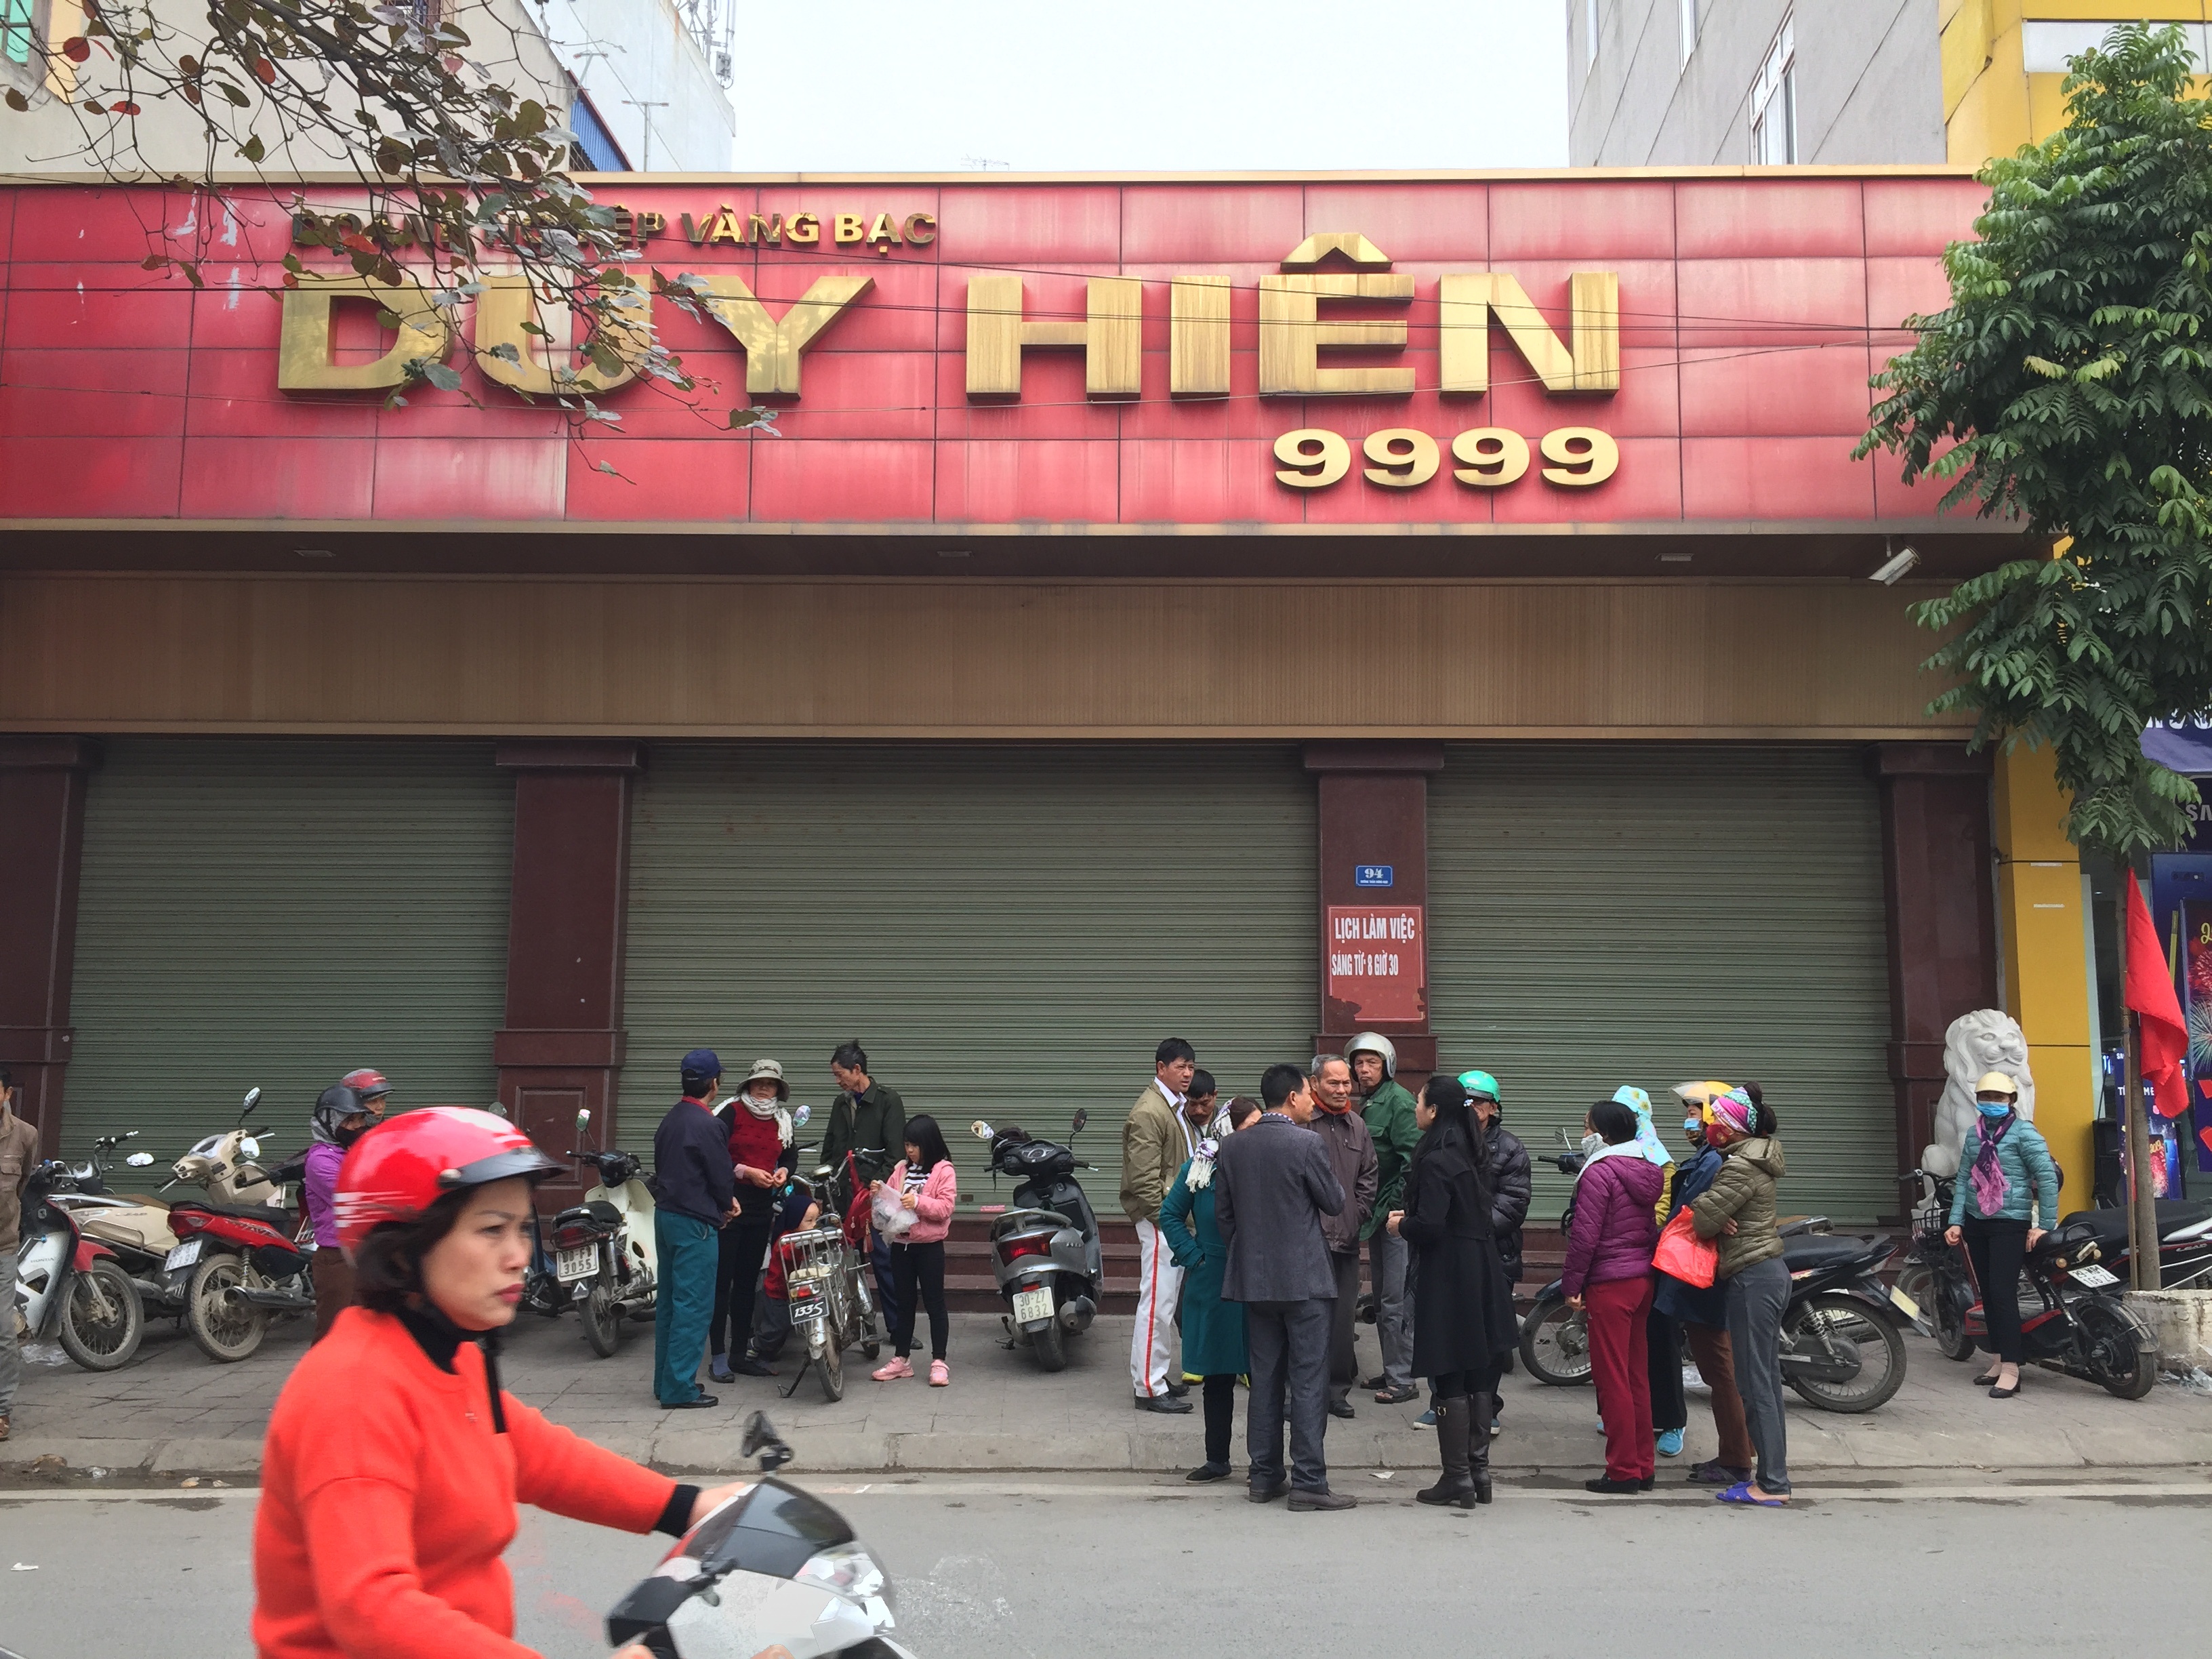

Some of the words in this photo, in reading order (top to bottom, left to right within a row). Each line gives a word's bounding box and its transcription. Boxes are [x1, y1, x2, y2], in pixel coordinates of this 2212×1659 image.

[680, 203, 819, 243] VÀNG
[835, 213, 937, 255] BẠC
[278, 272, 875, 400] DUY
[966, 232, 1620, 400] HIÊN
[1273, 426, 1620, 488] 9999
[1364, 868, 1383, 878] 94
[1335, 918, 1359, 943] LỊCH
[1363, 914, 1387, 939] LÀM
[1390, 914, 1415, 943] VIỆC
[1332, 950, 1352, 976] SÁNG
[1354, 949, 1366, 976] TỪ
[1368, 954, 1372, 976] 8
[1374, 949, 1387, 976] GIỜ
[1389, 954, 1399, 976] 30
[564, 1258, 592, 1275] 3055
[1021, 1303, 1048, 1320] 6832
